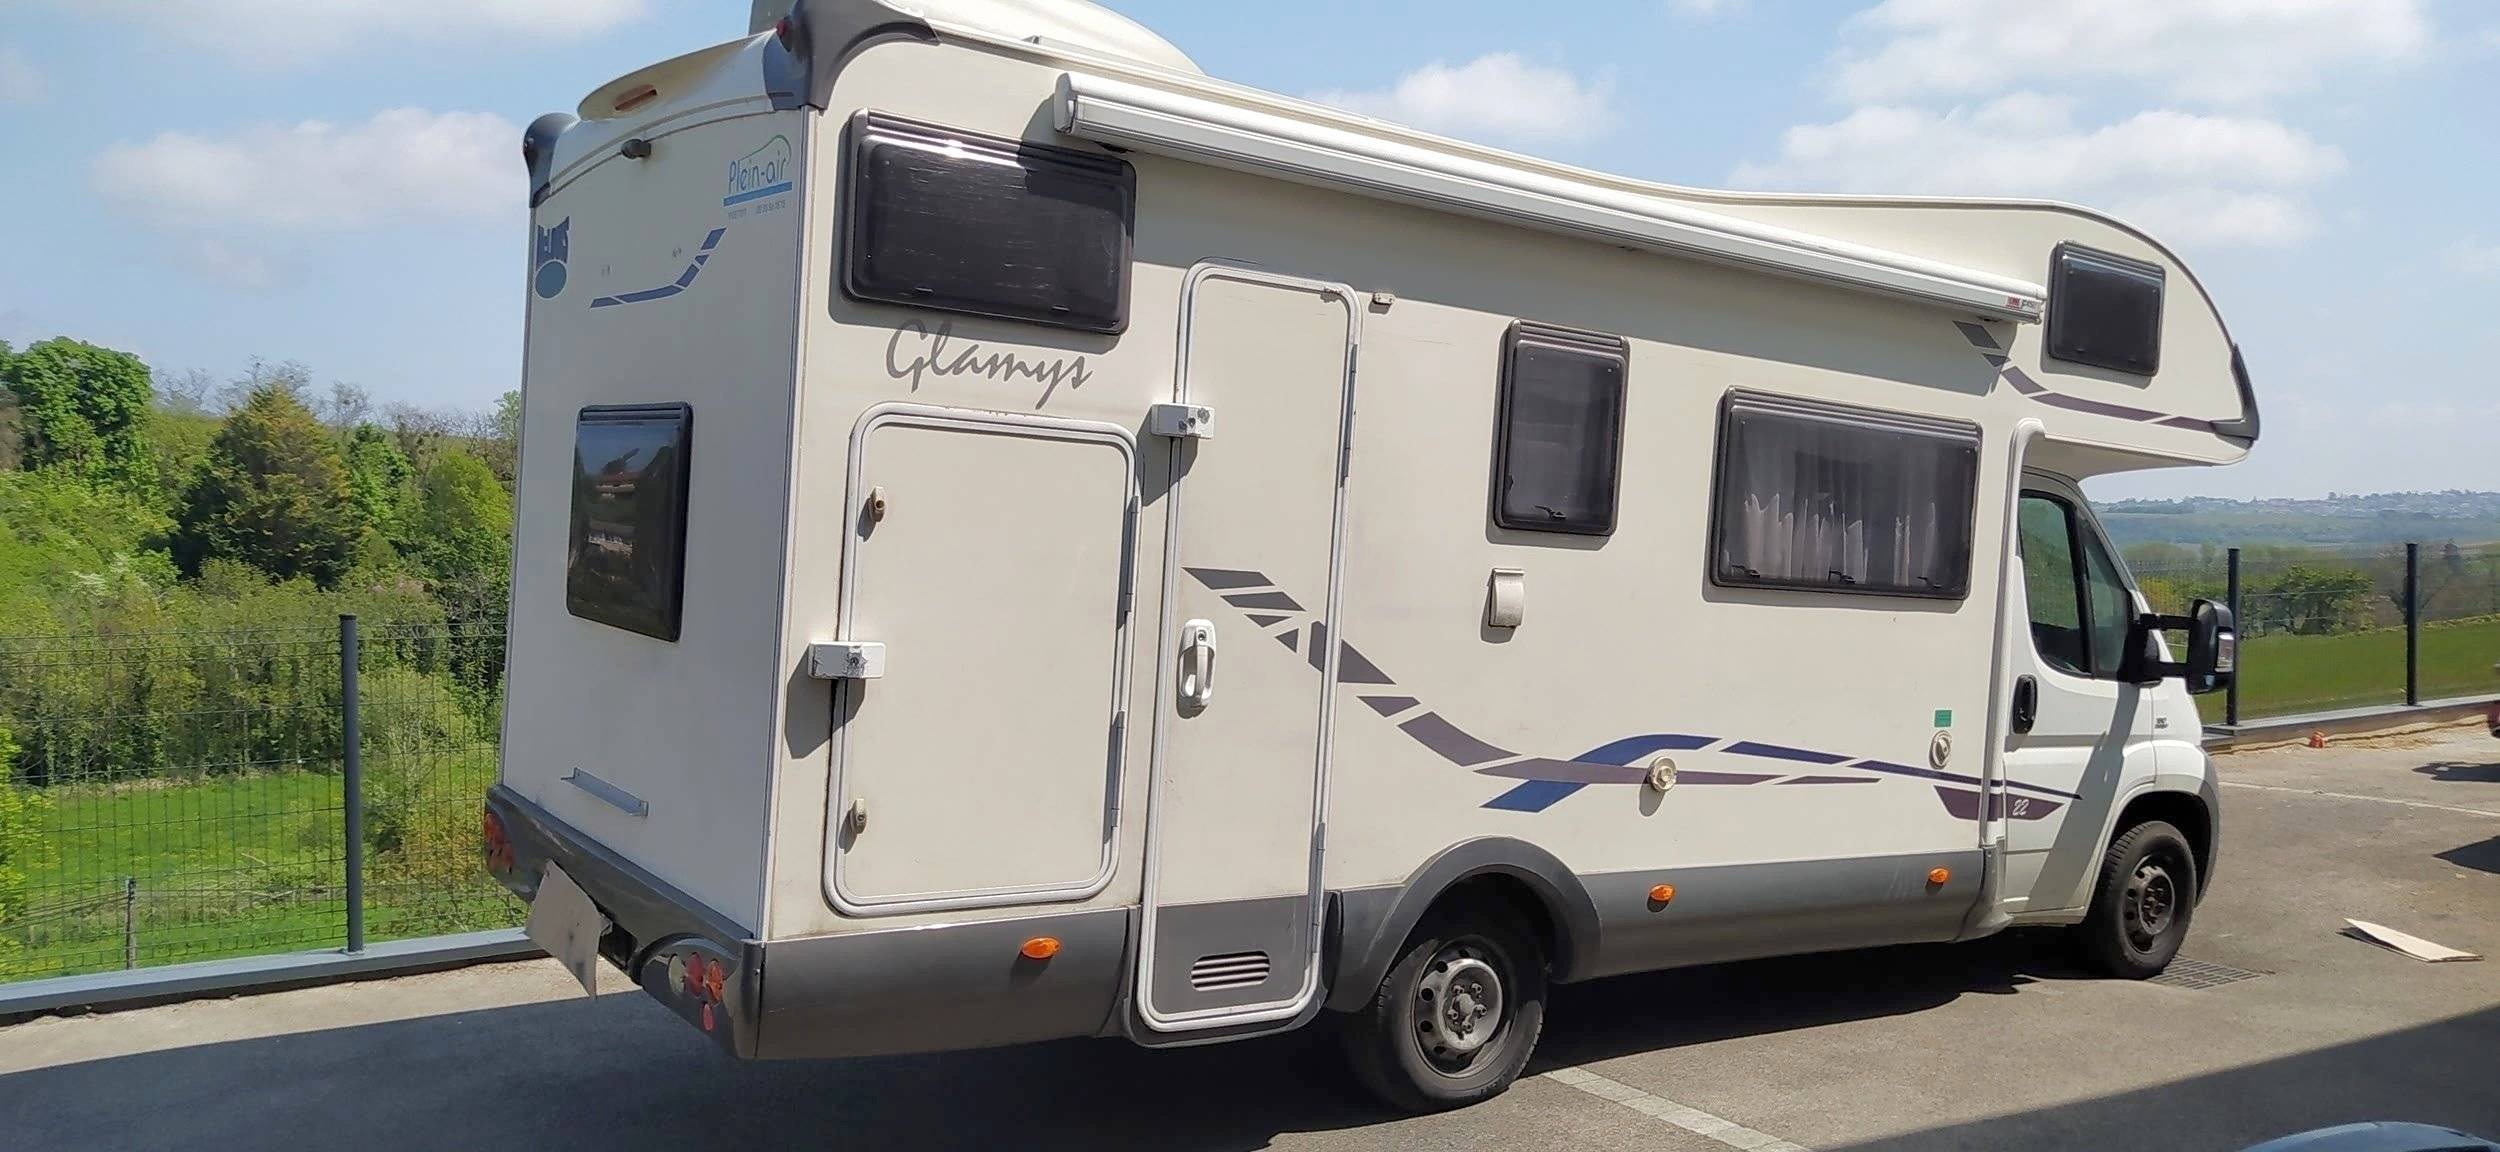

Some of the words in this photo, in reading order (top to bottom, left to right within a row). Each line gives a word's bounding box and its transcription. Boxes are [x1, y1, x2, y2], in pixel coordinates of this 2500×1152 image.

[728, 150, 789, 194] Plein-air
[886, 319, 1093, 409] Glamys
[2012, 799, 2029, 816] 22
